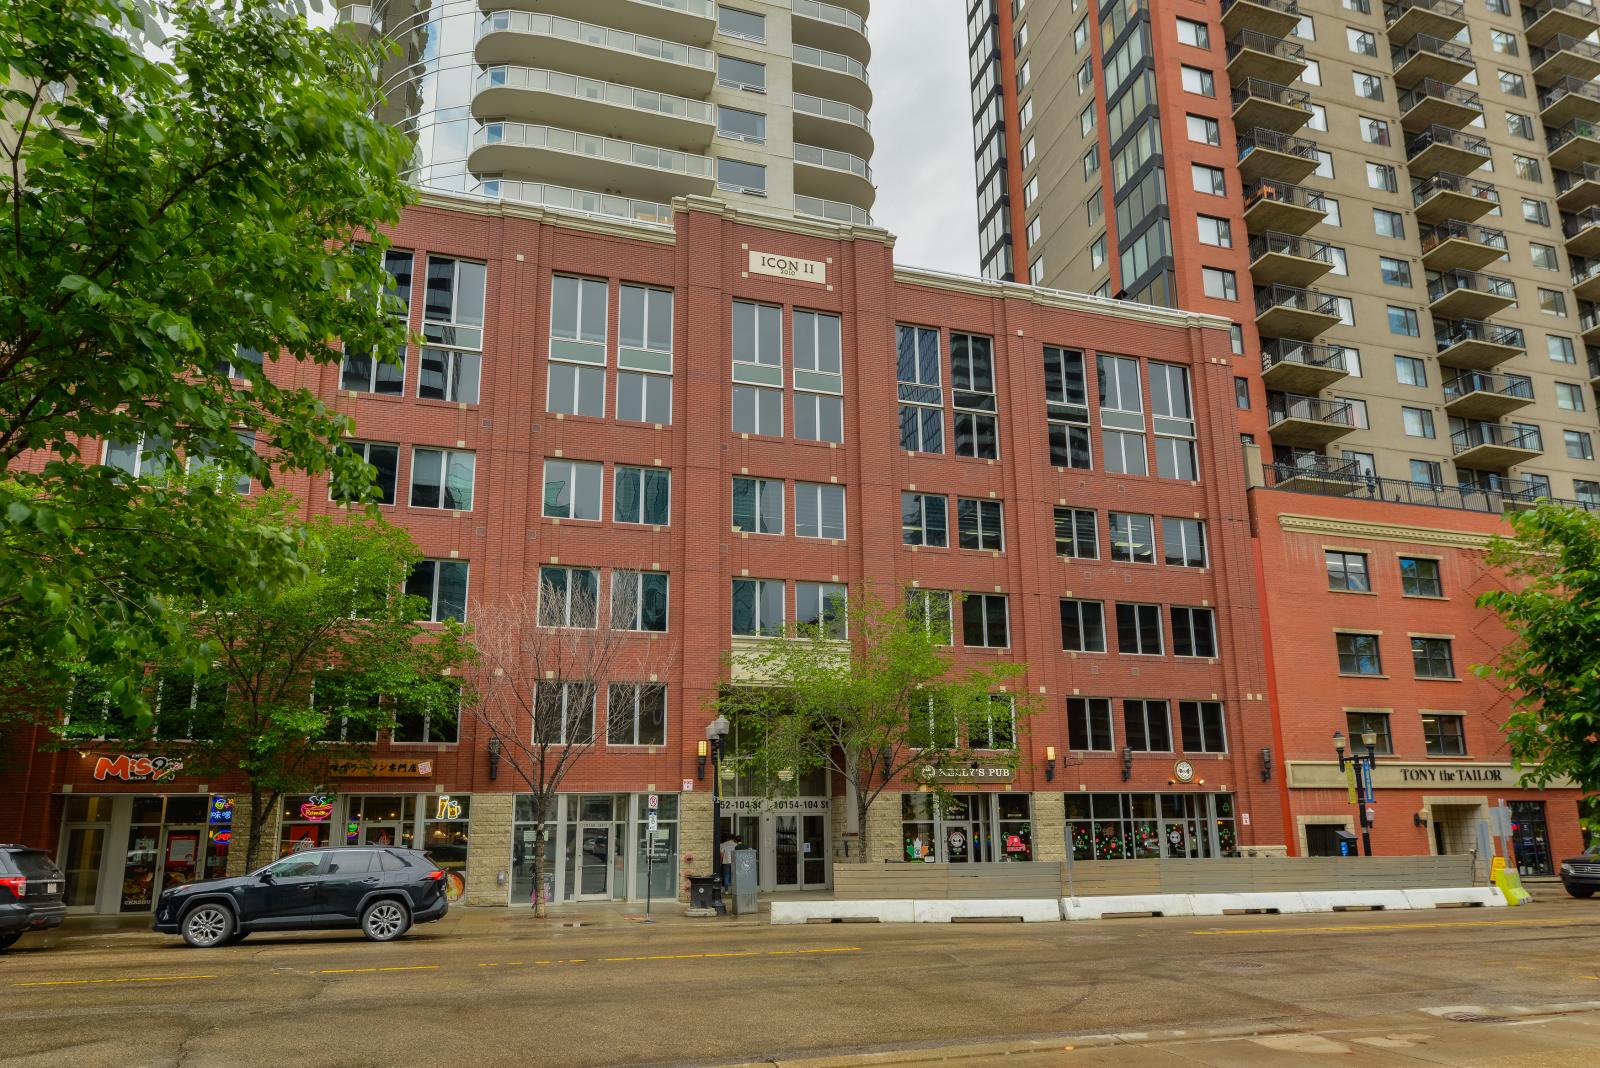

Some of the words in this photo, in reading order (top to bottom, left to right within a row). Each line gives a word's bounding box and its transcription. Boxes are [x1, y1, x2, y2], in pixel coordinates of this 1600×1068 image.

[761, 256, 799, 272] ICON
[804, 264, 814, 274] II
[988, 768, 1010, 777] PUB
[1400, 768, 1436, 781] TONY
[1439, 769, 1455, 781] the
[1456, 769, 1502, 781] TAILOR
[773, 800, 818, 809] 10154-104
[820, 800, 829, 809] St
